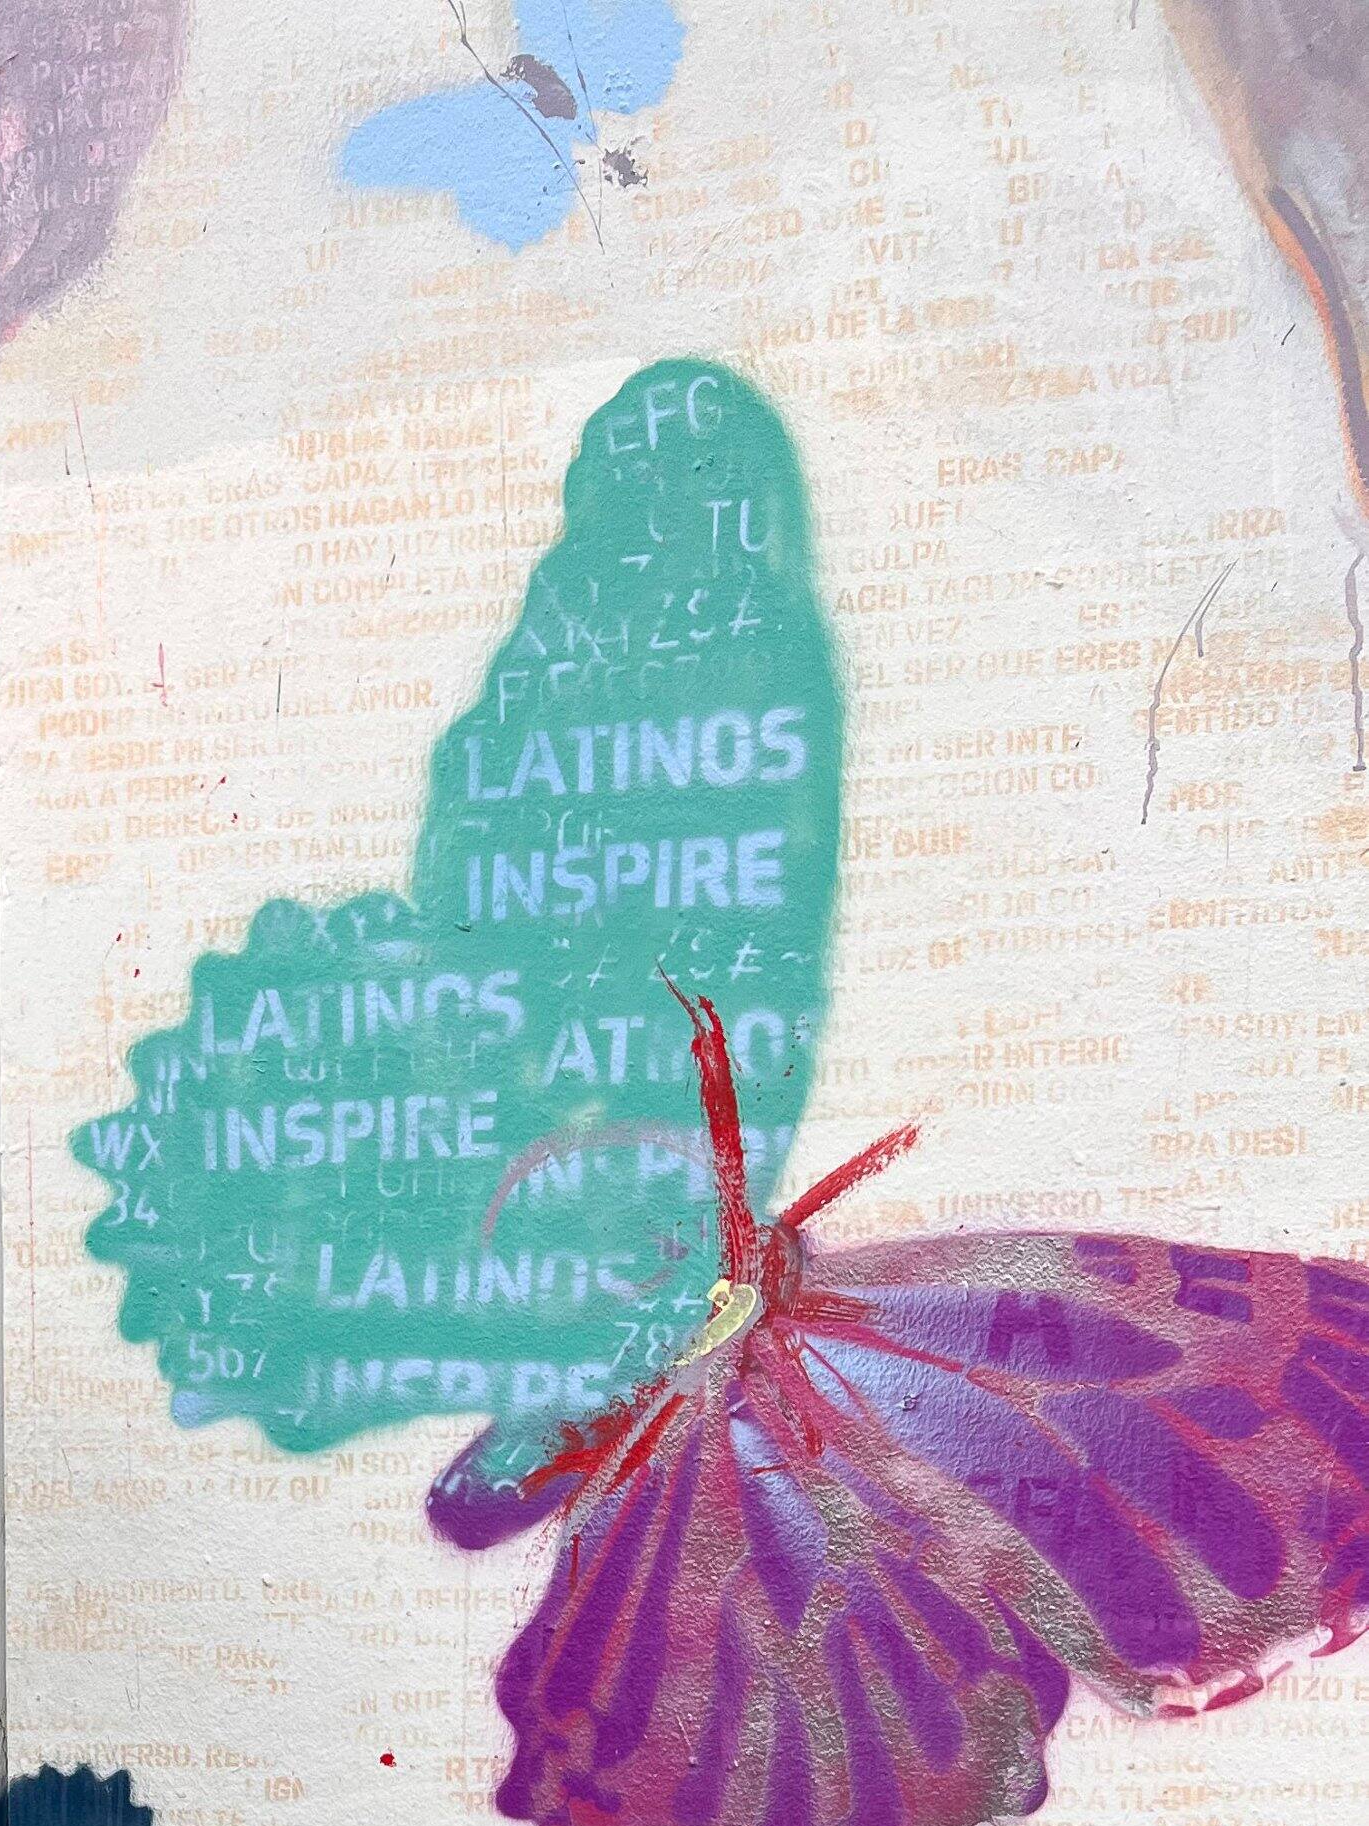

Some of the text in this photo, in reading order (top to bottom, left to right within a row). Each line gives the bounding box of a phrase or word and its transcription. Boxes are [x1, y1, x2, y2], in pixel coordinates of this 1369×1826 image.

[938, 451, 1023, 485] ERAS
[329, 491, 431, 528] HAGAN
[437, 487, 477, 519] LO
[902, 649, 967, 687] SER
[1054, 639, 1140, 673] ERES
[462, 705, 812, 802] LATINOS
[932, 727, 998, 762] SER
[466, 828, 787, 921] INSPIRE
[200, 968, 527, 1053] LATINOS
[202, 1090, 500, 1173] INSPIRE
